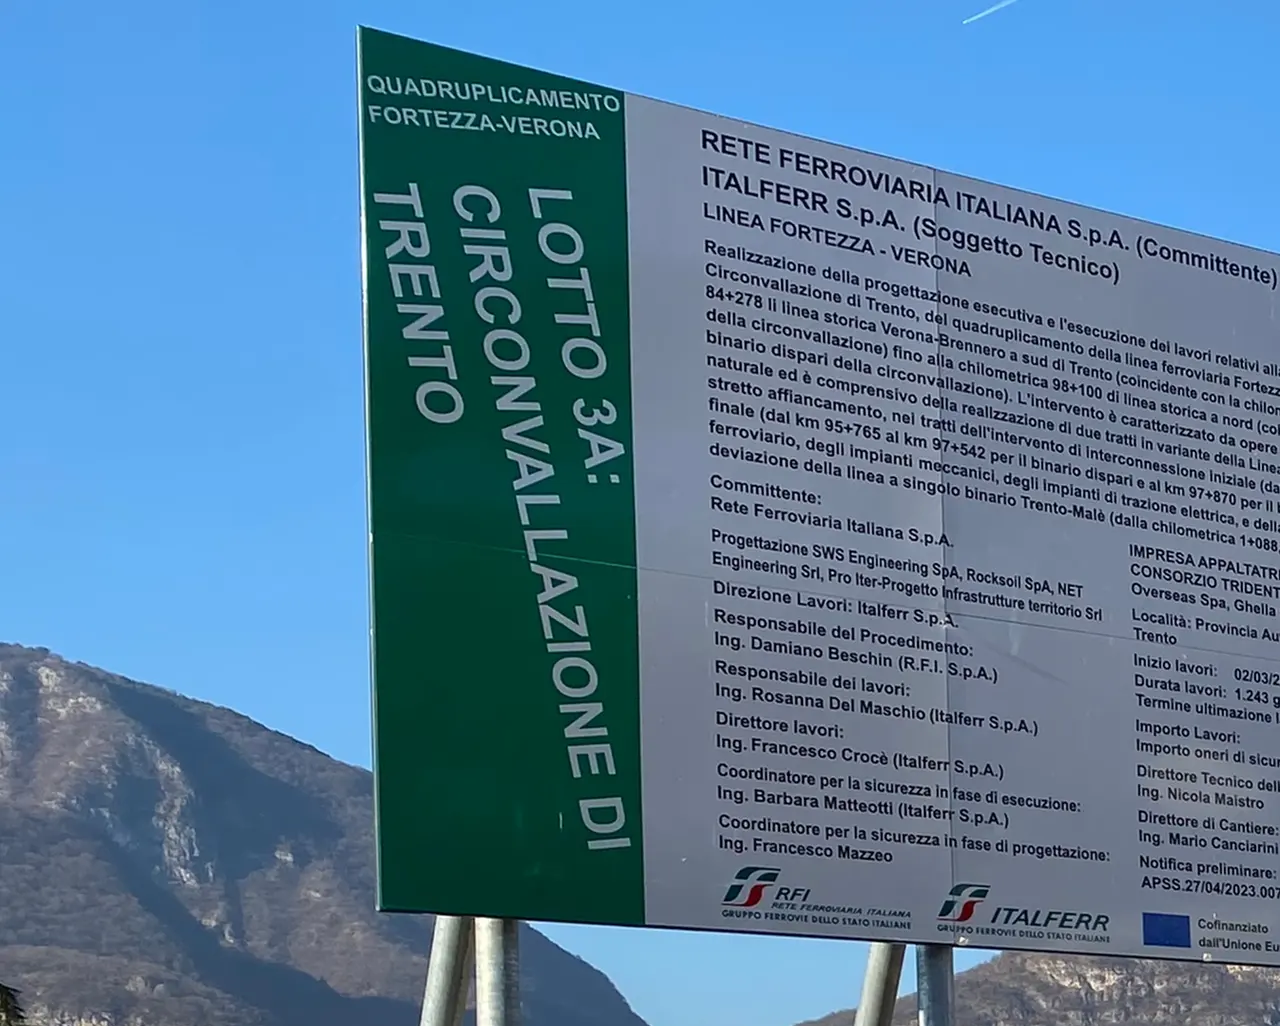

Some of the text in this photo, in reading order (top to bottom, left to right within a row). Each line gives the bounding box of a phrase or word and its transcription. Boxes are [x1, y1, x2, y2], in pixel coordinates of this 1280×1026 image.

[366, 75, 621, 113] QUADRUPLICAMENTO
[368, 105, 600, 140] FORTEZZA-VERONA
[701, 128, 1278, 291] RETE FERROVIARIA ITALIANA S.p.A. (Committente)
[702, 165, 1120, 286] ITALFERR S.p.A. (Soggetto Tecnico)
[703, 201, 766, 232] LINEA
[769, 216, 876, 257] FORTEZZA
[889, 244, 972, 278] VERONA
[372, 182, 465, 425] TRENTO
[704, 238, 817, 277] Realizzazione
[821, 265, 860, 287] della
[864, 277, 970, 310] progettazione
[972, 301, 1044, 326] esecutiva
[1059, 316, 1146, 349] l'esecuzione
[1149, 337, 1171, 354] dei
[1174, 341, 1212, 363] lavori
[1215, 353, 1260, 373] relativi
[528, 188, 626, 485] LOTTO 3A:
[705, 262, 842, 304] Circonvallazione
[846, 293, 862, 309] di
[864, 295, 920, 323] Trento,
[924, 309, 948, 327] del
[951, 317, 1085, 356] quadruplicamento
[1087, 344, 1122, 364] della
[1124, 351, 1158, 372] linea
[1161, 359, 1231, 387] ferroviaria
[709, 473, 822, 506] Committente:
[709, 442, 799, 470] deviazione
[803, 458, 843, 478] della
[846, 464, 885, 485] linea
[902, 475, 961, 498] singolo
[964, 485, 1017, 507] binario
[1019, 494, 1106, 523] Trento-Malè
[1109, 510, 1149, 530] (dalla
[1151, 519, 1236, 546] chilometrica
[452, 183, 631, 851] CIRCONVALLAZIONE DI
[710, 495, 955, 548] Rete Ferroviaria Italiana S.p.A.
[1128, 543, 1196, 568] IMPRESA
[1130, 562, 1218, 589] CONSORZIO
[713, 607, 974, 657] Responsabile del Procedimento:
[714, 630, 998, 685] Ing. Damiano Beschin (R.F.I. S.p.A.)
[1133, 652, 1172, 671] Inizio
[1174, 658, 1218, 677] lavori:
[715, 659, 911, 698] Responsabile dei lavori:
[1134, 673, 1181, 693] Durata
[1184, 680, 1227, 699] lavori:
[1234, 687, 1270, 705] 1.243
[715, 682, 1039, 738] Ing. Rosanna Del Maschio (Italferr S.p.A.)
[715, 710, 844, 739] Direttore lavori:
[1134, 692, 1192, 714] Termine
[1194, 701, 1273, 724] ultimazione
[716, 733, 1004, 782] Ing. Francesco Crocè (Italferr S.p.A.)
[1136, 763, 1198, 784] Direttore
[1200, 771, 1254, 790] Tecnico
[717, 784, 1010, 830] Ing. Barbara Matteotti (Italferr S.p.A.)
[1137, 783, 1265, 810] Ing. Nicola Maistro
[1137, 809, 1280, 837] Direttore di Cantiere:
[718, 834, 894, 863] Ing. Francesco Mazzeo
[1138, 828, 1279, 855] Ing. Mario Canciarini
[1139, 854, 1277, 880] Notifica preliminare:
[774, 886, 811, 903] RFI
[990, 906, 1110, 932] ITALFERR
[1197, 917, 1269, 935] Cofinanziato
[1198, 936, 1263, 952] dall'Unione
